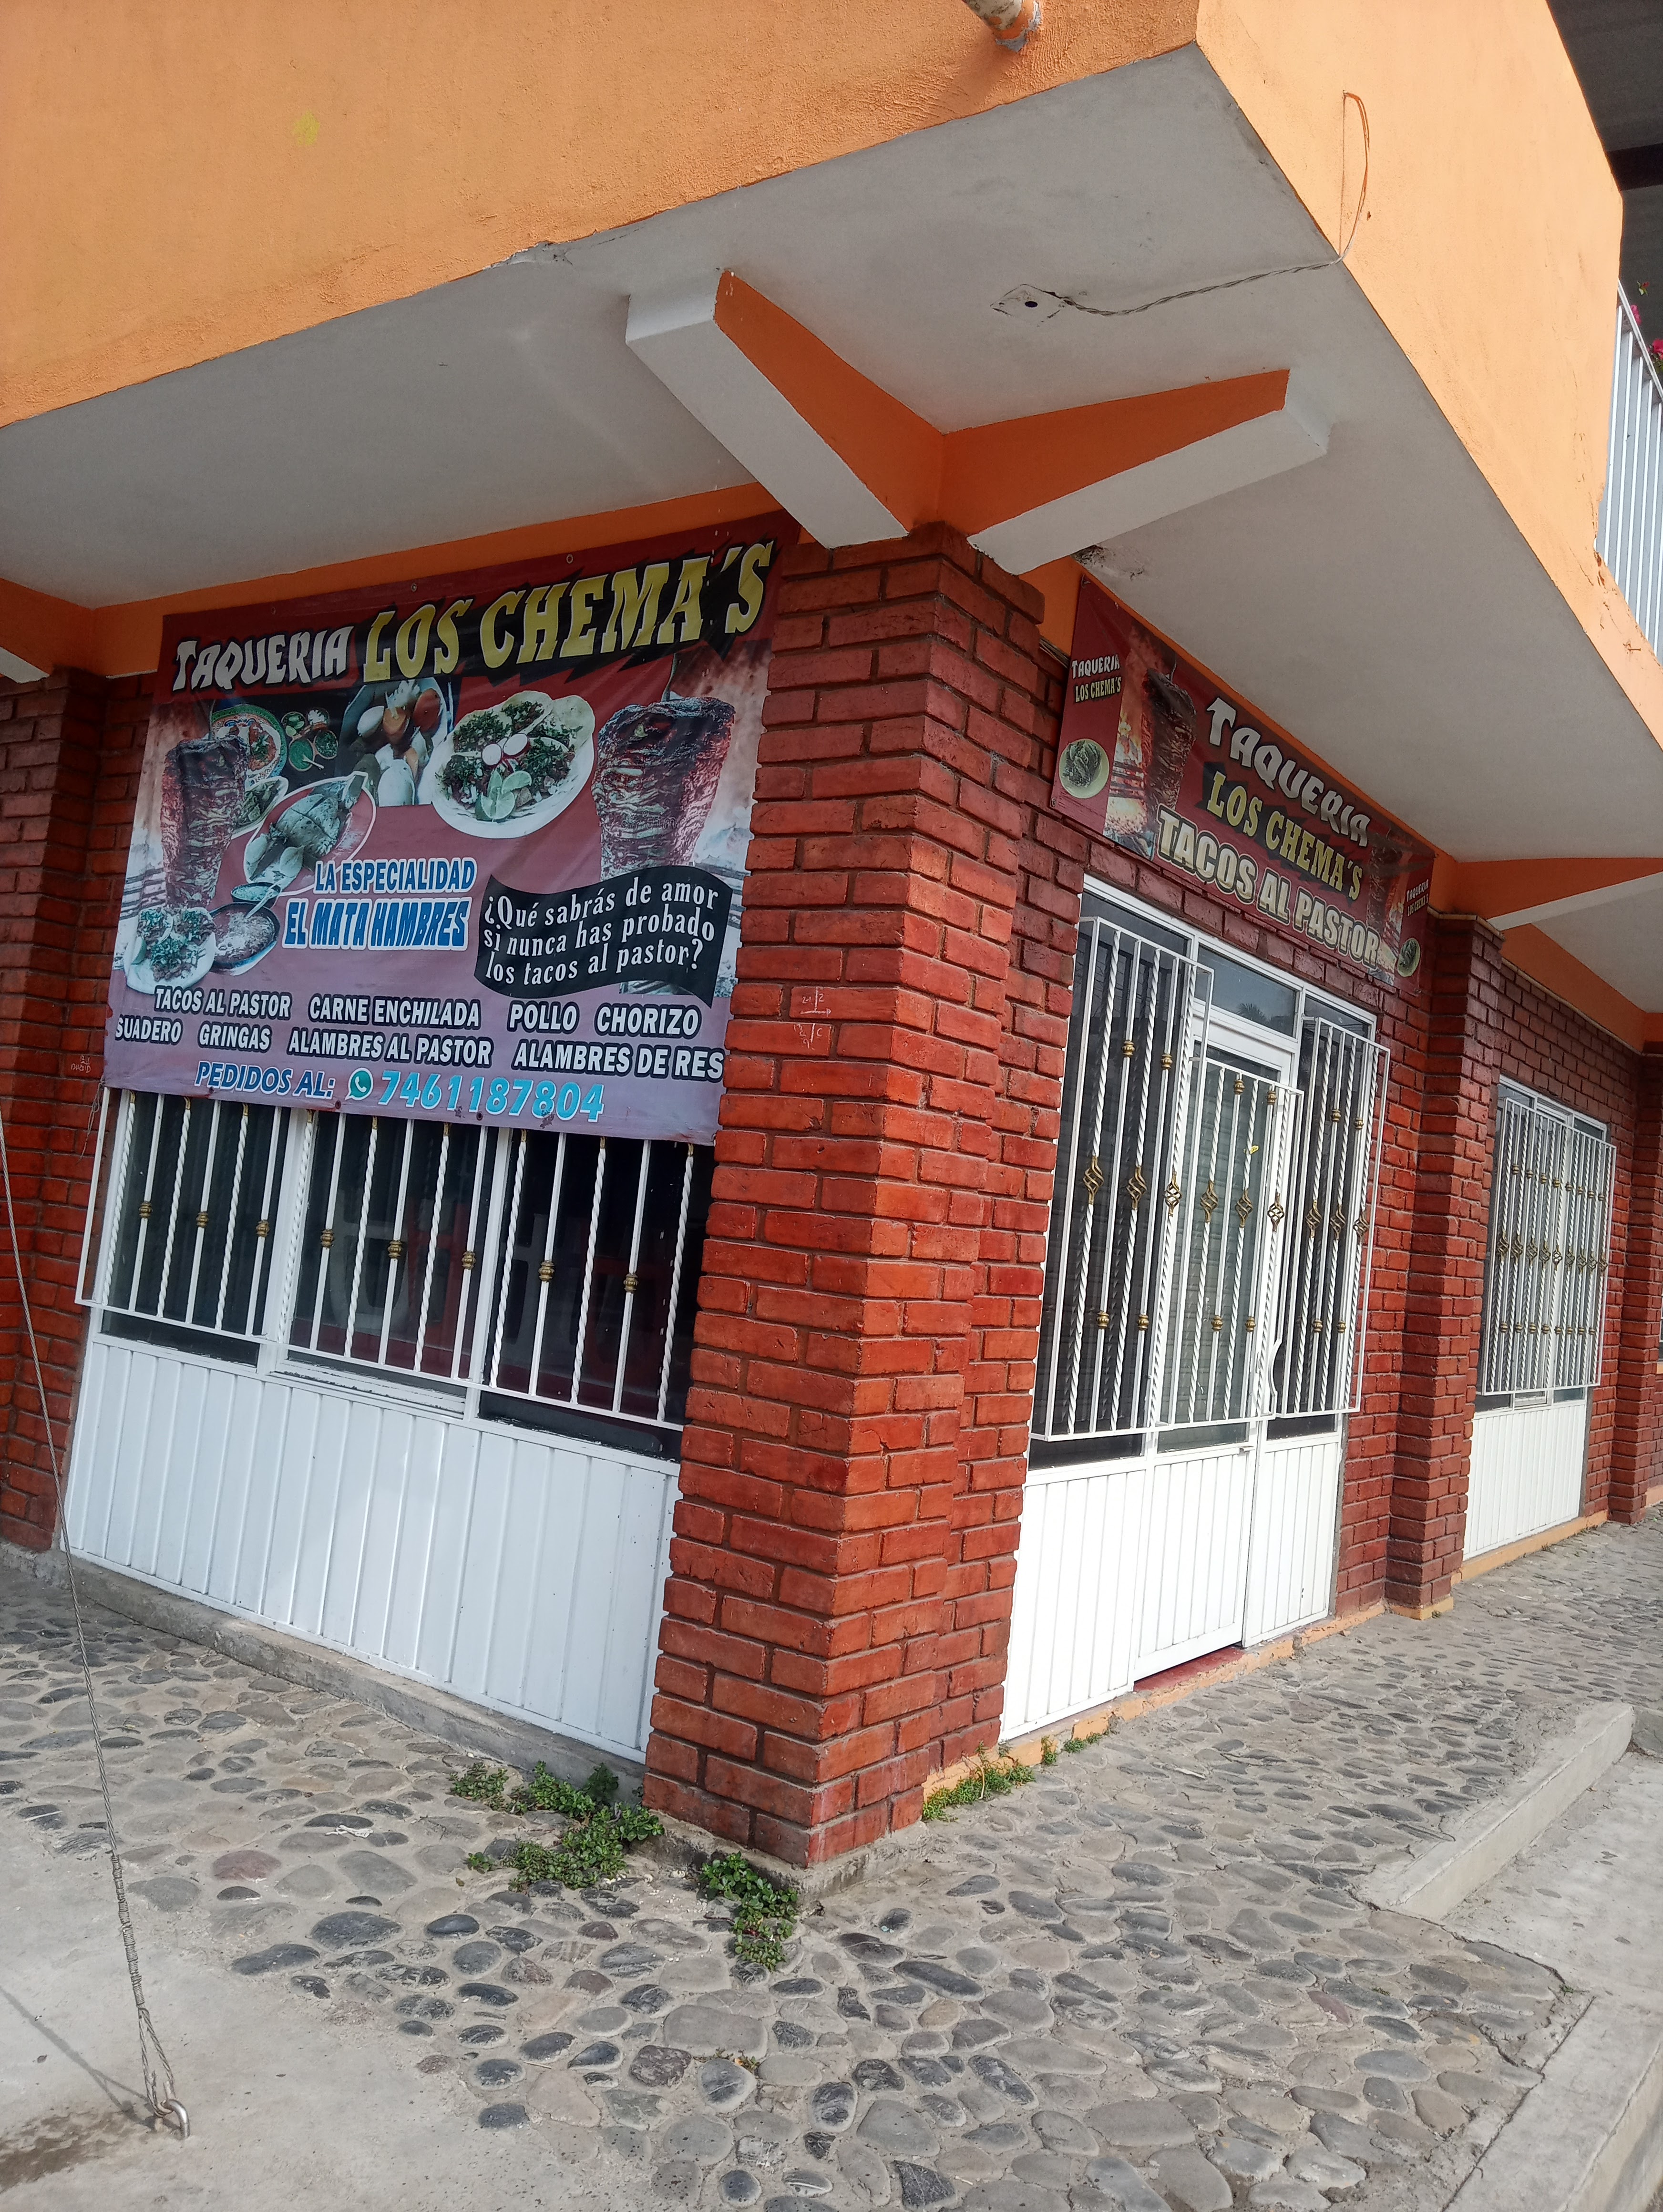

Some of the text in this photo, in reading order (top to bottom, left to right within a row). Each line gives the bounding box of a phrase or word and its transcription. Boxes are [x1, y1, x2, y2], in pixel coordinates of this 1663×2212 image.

[172, 625, 355, 692] TAQUERIA
[362, 598, 473, 683] LOS
[1071, 654, 1120, 679] TAQUERIA
[1075, 684, 1089, 703] LOS
[1206, 697, 1371, 847] TAQUERIA
[1207, 770, 1263, 837] LOS
[314, 858, 477, 893] LA ESPECIALIDAD
[1157, 803, 1381, 969] TACOS AL PASTOR
[1406, 879, 1429, 902] TAQUERIA
[282, 898, 471, 950] EL MATA HAMBRES
[484, 877, 719, 929] ¿Qué sabrás de amor
[484, 903, 715, 956] si nunca has probado
[485, 938, 703, 985] los tacos al pastor?
[155, 988, 699, 1036] TACOS AL PASTOR CARNE ENCHILADA POLLO CHORIZO
[115, 1016, 724, 1079] SUADERO GRINGAS ALAMBRES AL PASTOR ALAMBRES DE RES
[195, 1061, 605, 1123] PEDIDOS AL: 7461187804
